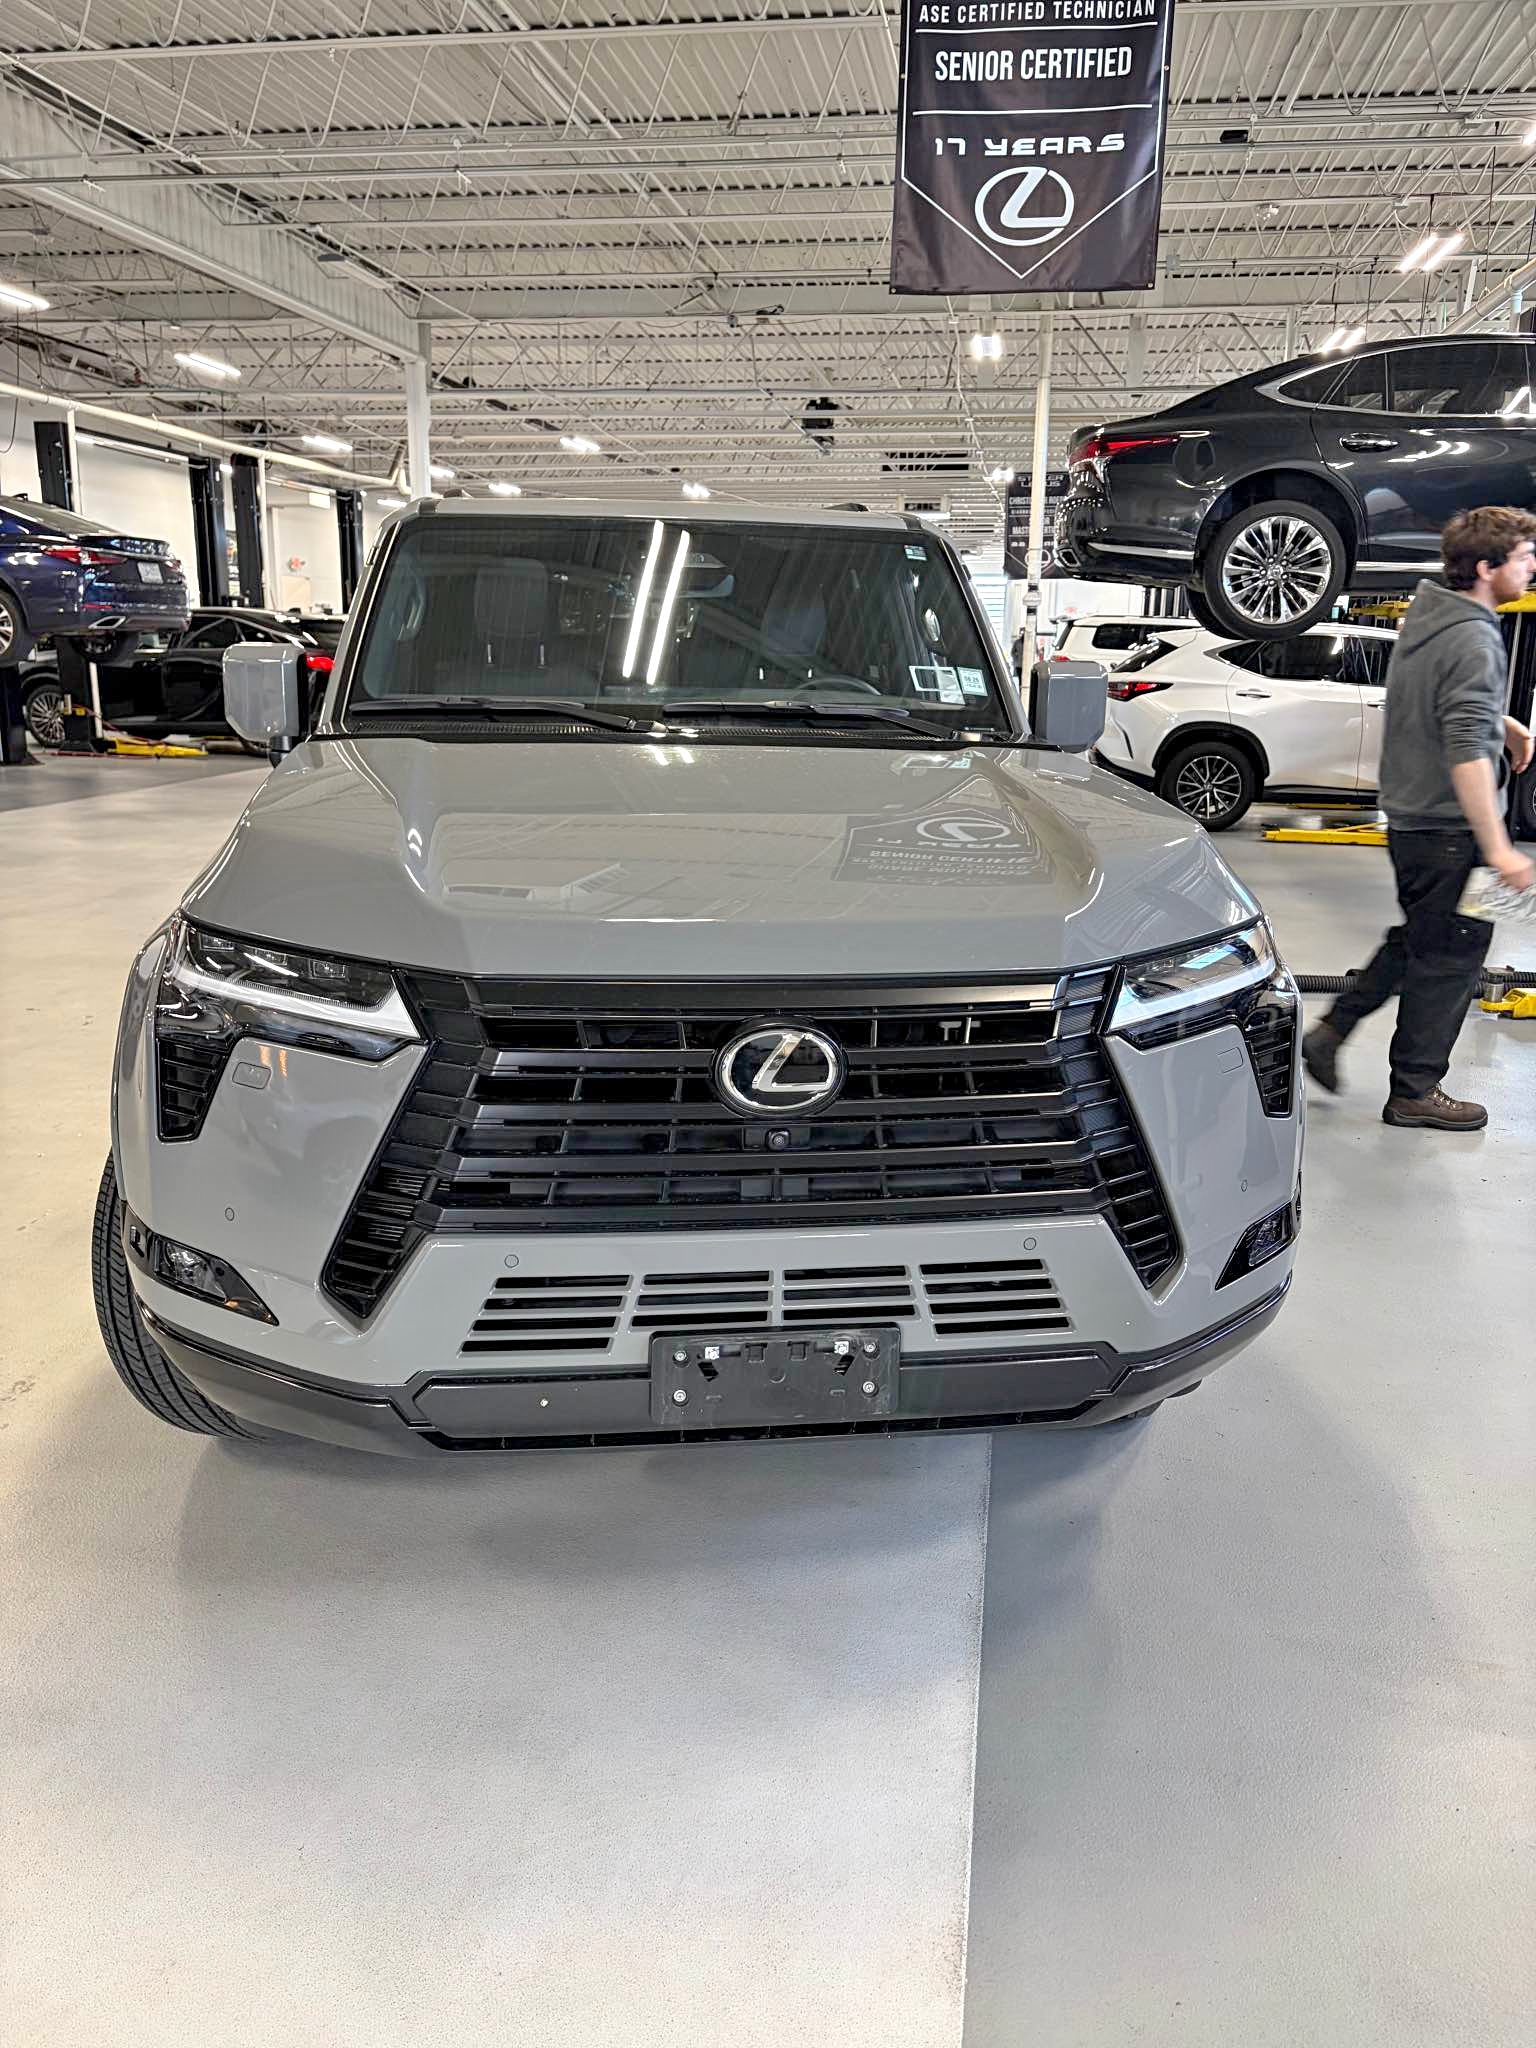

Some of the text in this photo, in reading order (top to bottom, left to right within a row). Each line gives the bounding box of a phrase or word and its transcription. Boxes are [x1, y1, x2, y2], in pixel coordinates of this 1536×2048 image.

[920, 0, 1154, 23] ASE CERTIFIED TECHNICIAN
[935, 47, 1131, 81] SENIOR CERTIFIED
[935, 134, 1124, 155] 17 YEARS
